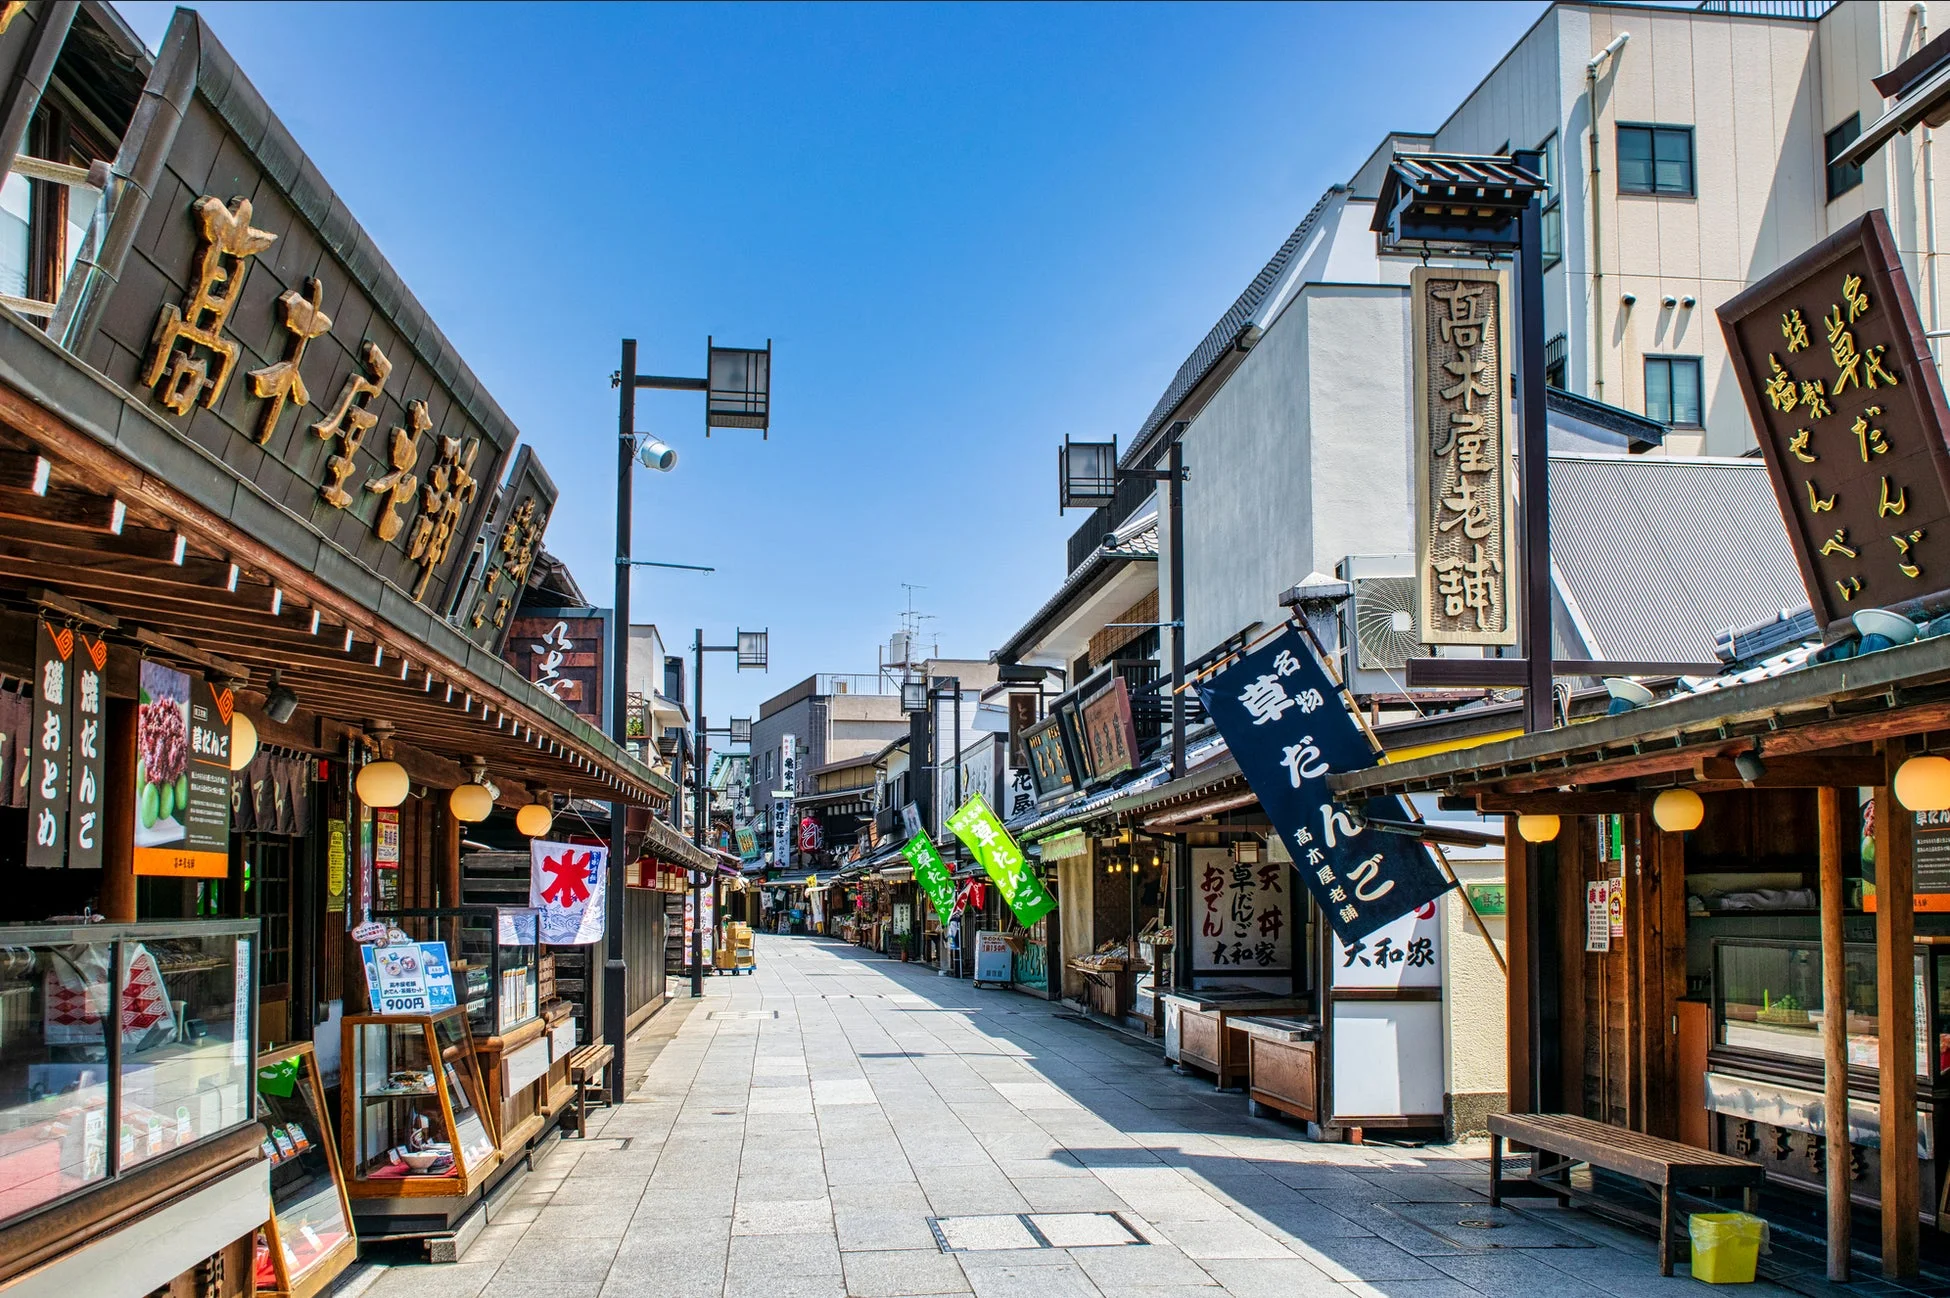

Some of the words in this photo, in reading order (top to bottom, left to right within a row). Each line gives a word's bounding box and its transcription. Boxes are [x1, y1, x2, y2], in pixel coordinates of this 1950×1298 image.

[191, 725, 229, 759] 草だんご
[1237, 674, 1395, 902] 草だんご
[540, 849, 592, 909] 氷
[970, 820, 1042, 907] 草だんご
[1200, 861, 1225, 938] おでん
[1228, 863, 1256, 939] 草だんご
[1212, 940, 1278, 967] 大和家
[386, 997, 425, 1011] 900円
